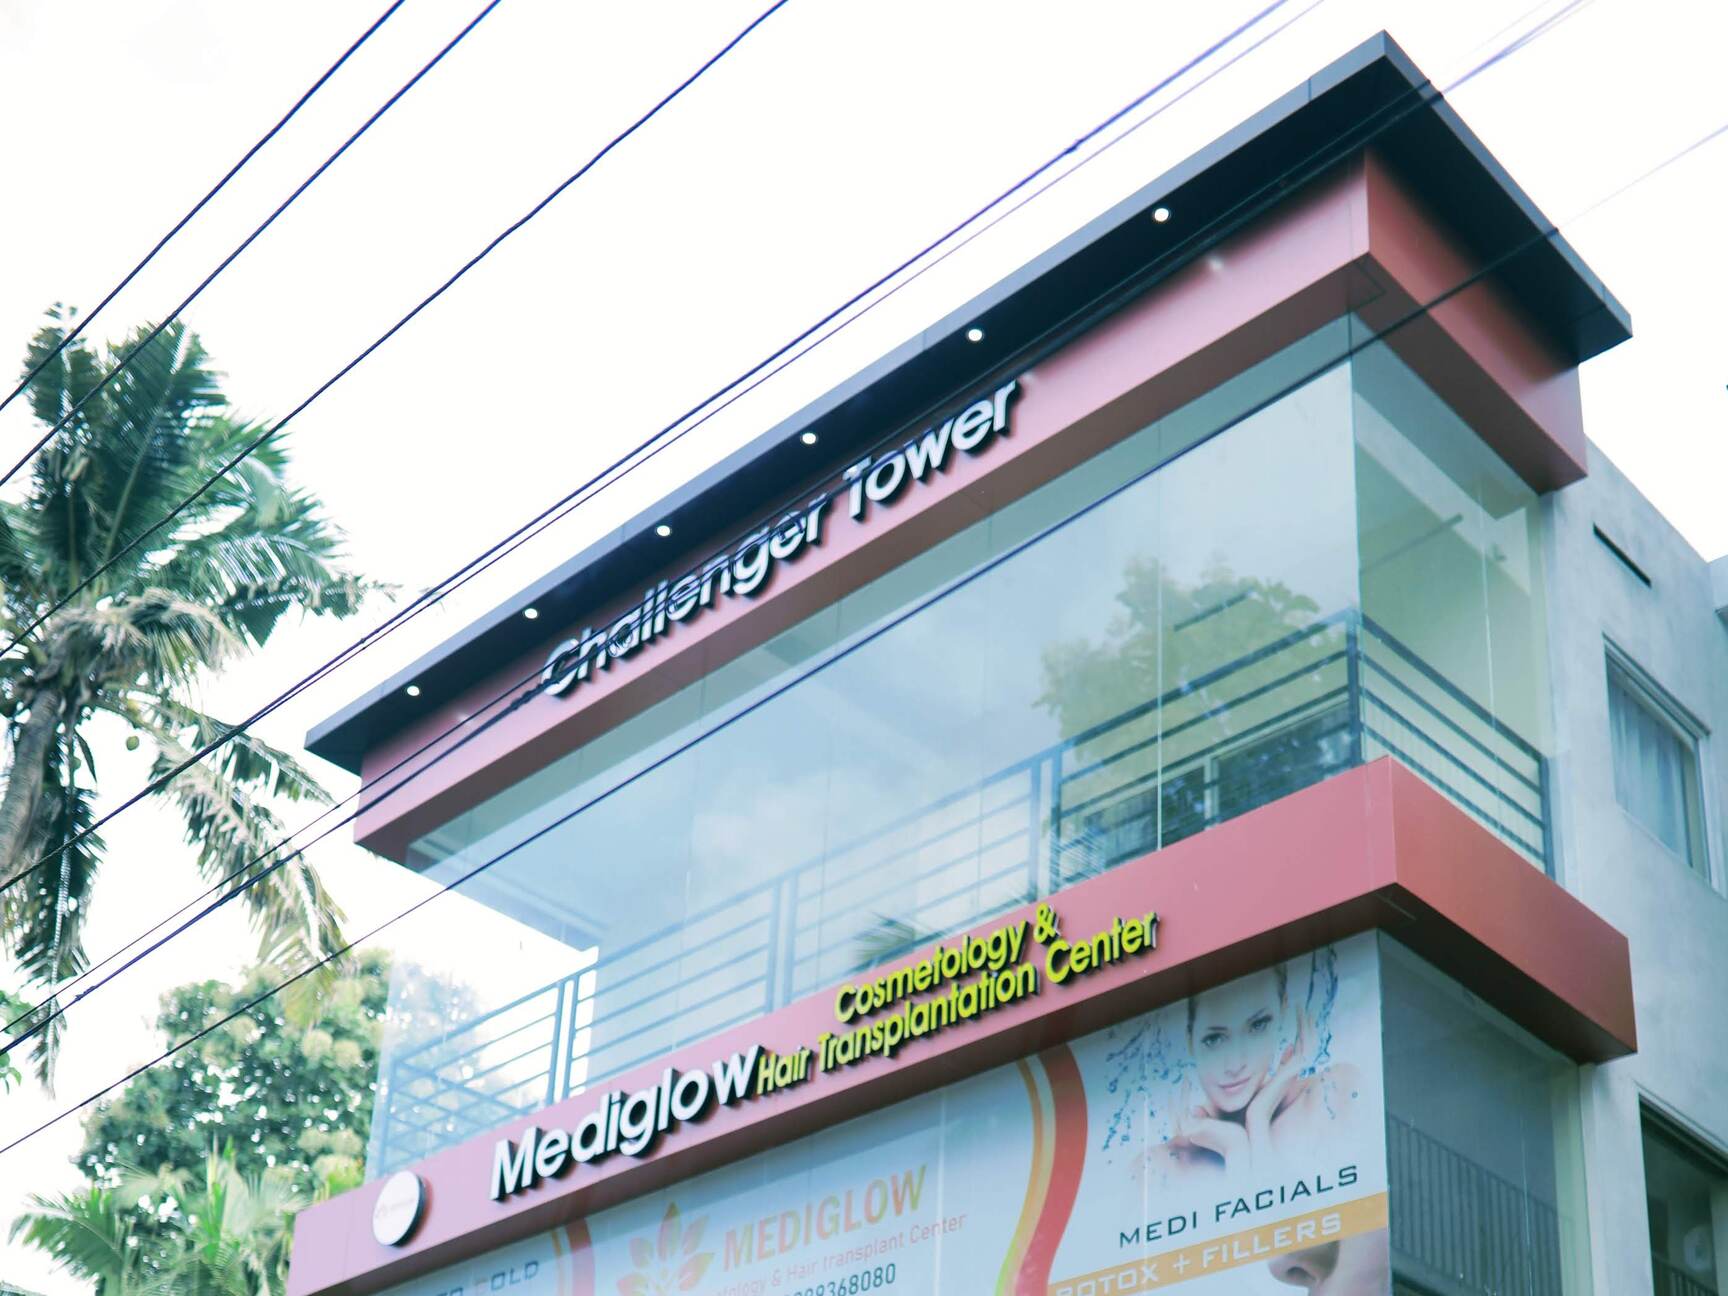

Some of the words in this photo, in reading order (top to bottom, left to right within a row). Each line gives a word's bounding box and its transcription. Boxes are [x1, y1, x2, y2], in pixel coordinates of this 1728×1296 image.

[541, 493, 829, 696] Challenger
[842, 379, 1017, 518] Tower
[757, 1047, 812, 1095] Hair
[817, 963, 1037, 1072] Transplantation
[1045, 911, 1158, 984] Center
[834, 919, 1030, 1024] Cosmetology
[1032, 902, 1060, 945] &
[490, 1044, 762, 1201] Mediglow
[723, 1164, 927, 1272] MEDIGLOW
[787, 1260, 818, 1282] Hair
[909, 1212, 968, 1245] Center
[1119, 1210, 1198, 1249] MEDI
[1214, 1165, 1359, 1223] FACIALS
[1202, 1212, 1343, 1269] FILLERS
